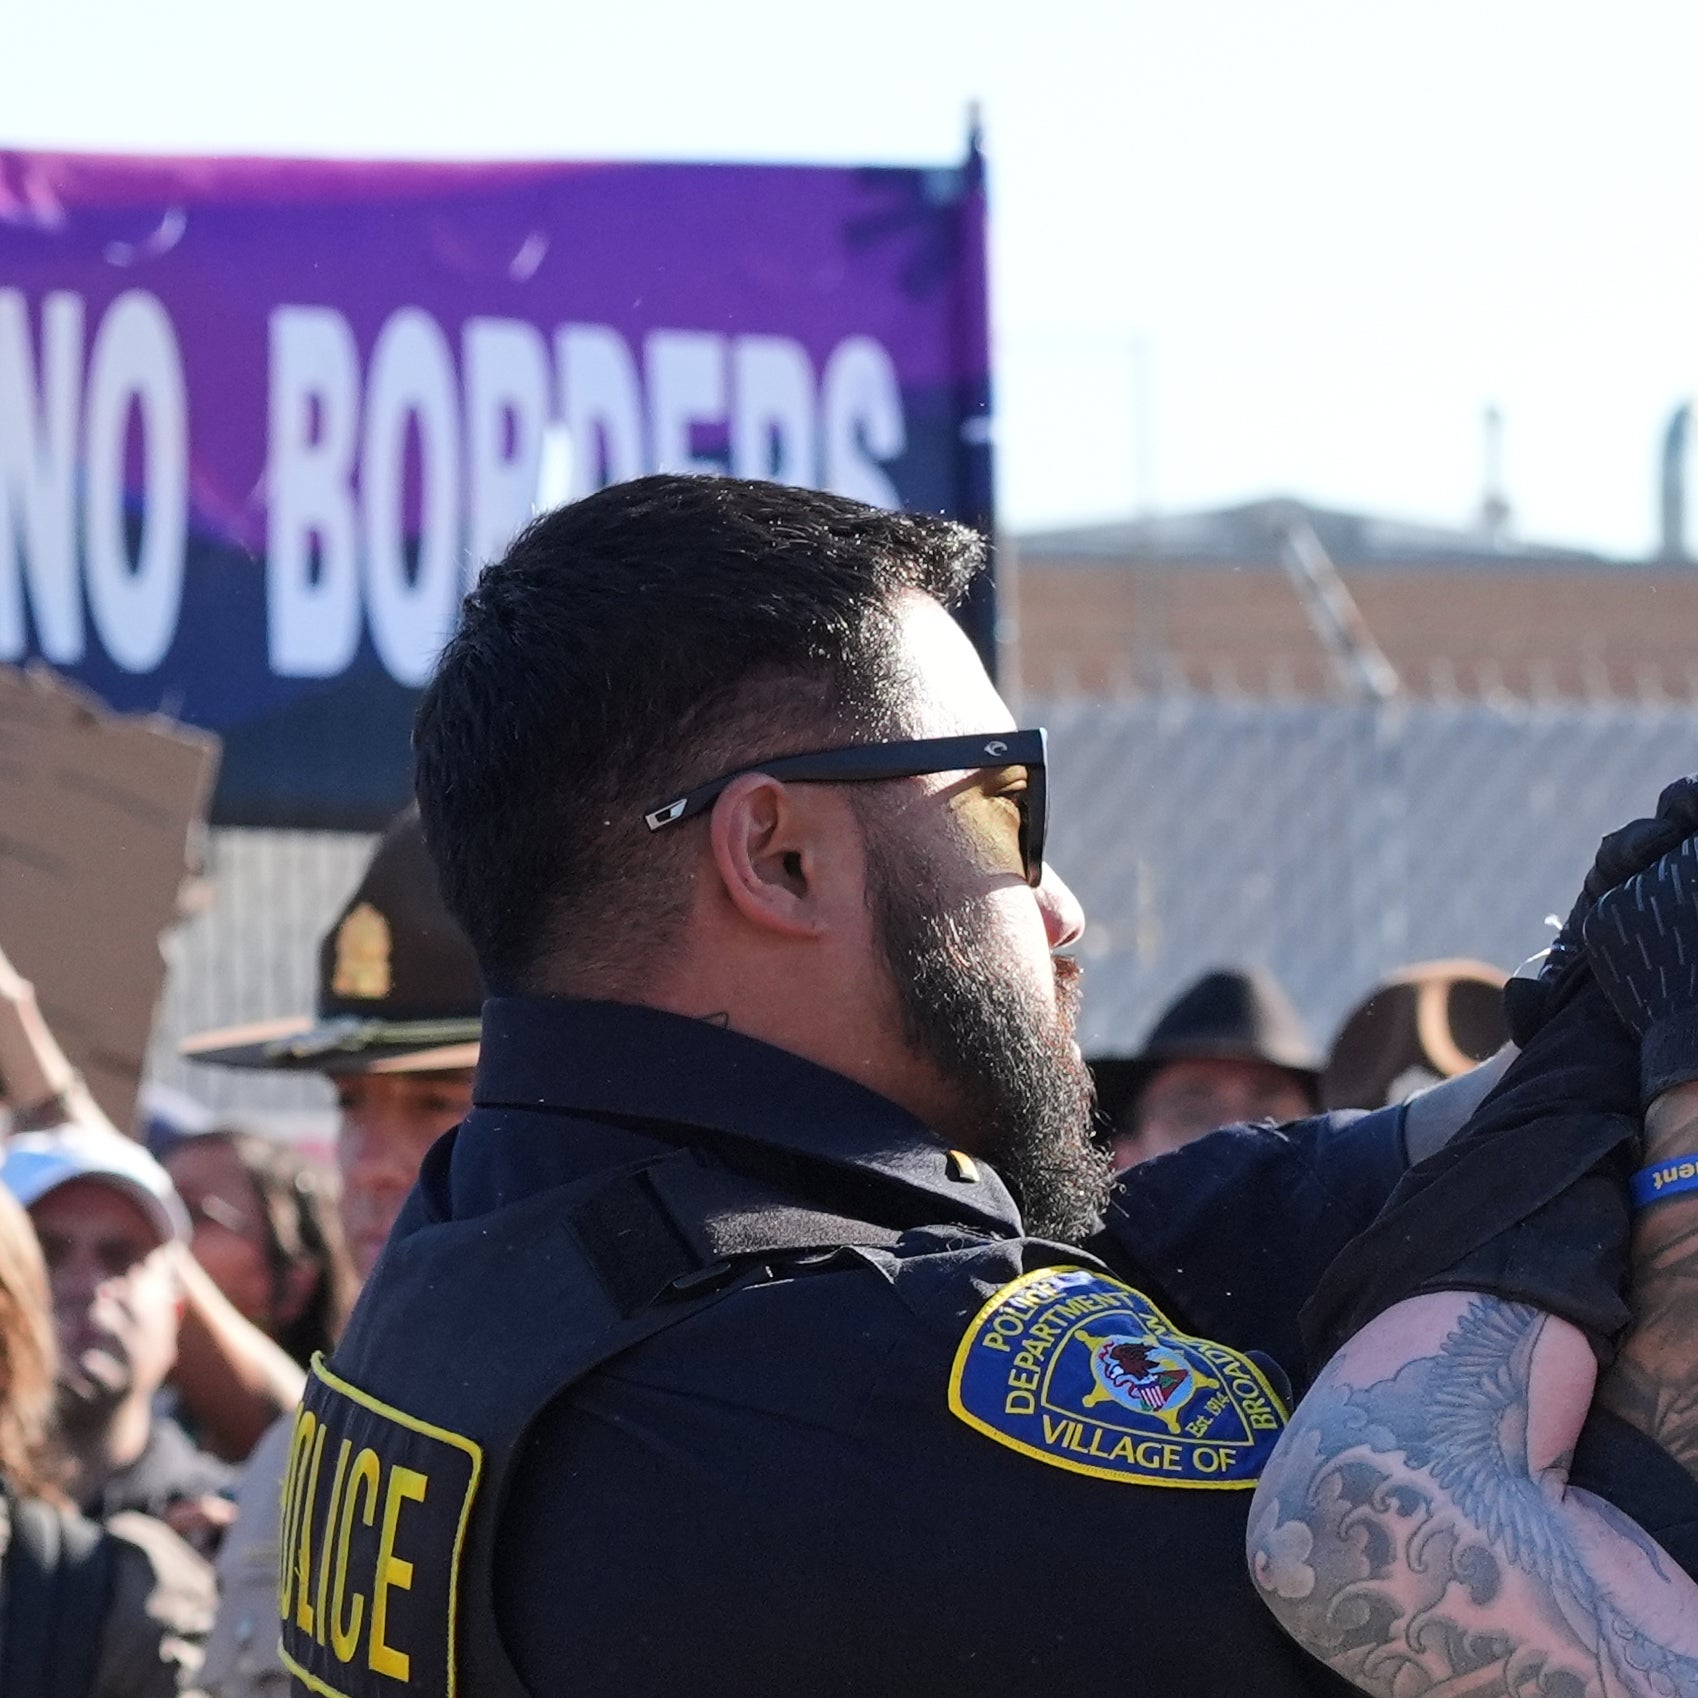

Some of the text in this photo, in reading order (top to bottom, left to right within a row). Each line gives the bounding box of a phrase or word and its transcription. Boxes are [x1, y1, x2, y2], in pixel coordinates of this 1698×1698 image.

[0, 286, 190, 676] NO
[1004, 1291, 1135, 1415] DEPARTMENT
[1138, 1312, 1279, 1430] BROADW
[1041, 1414, 1237, 1473] VILLAGE OF
[281, 1409, 429, 1684] OLICE
